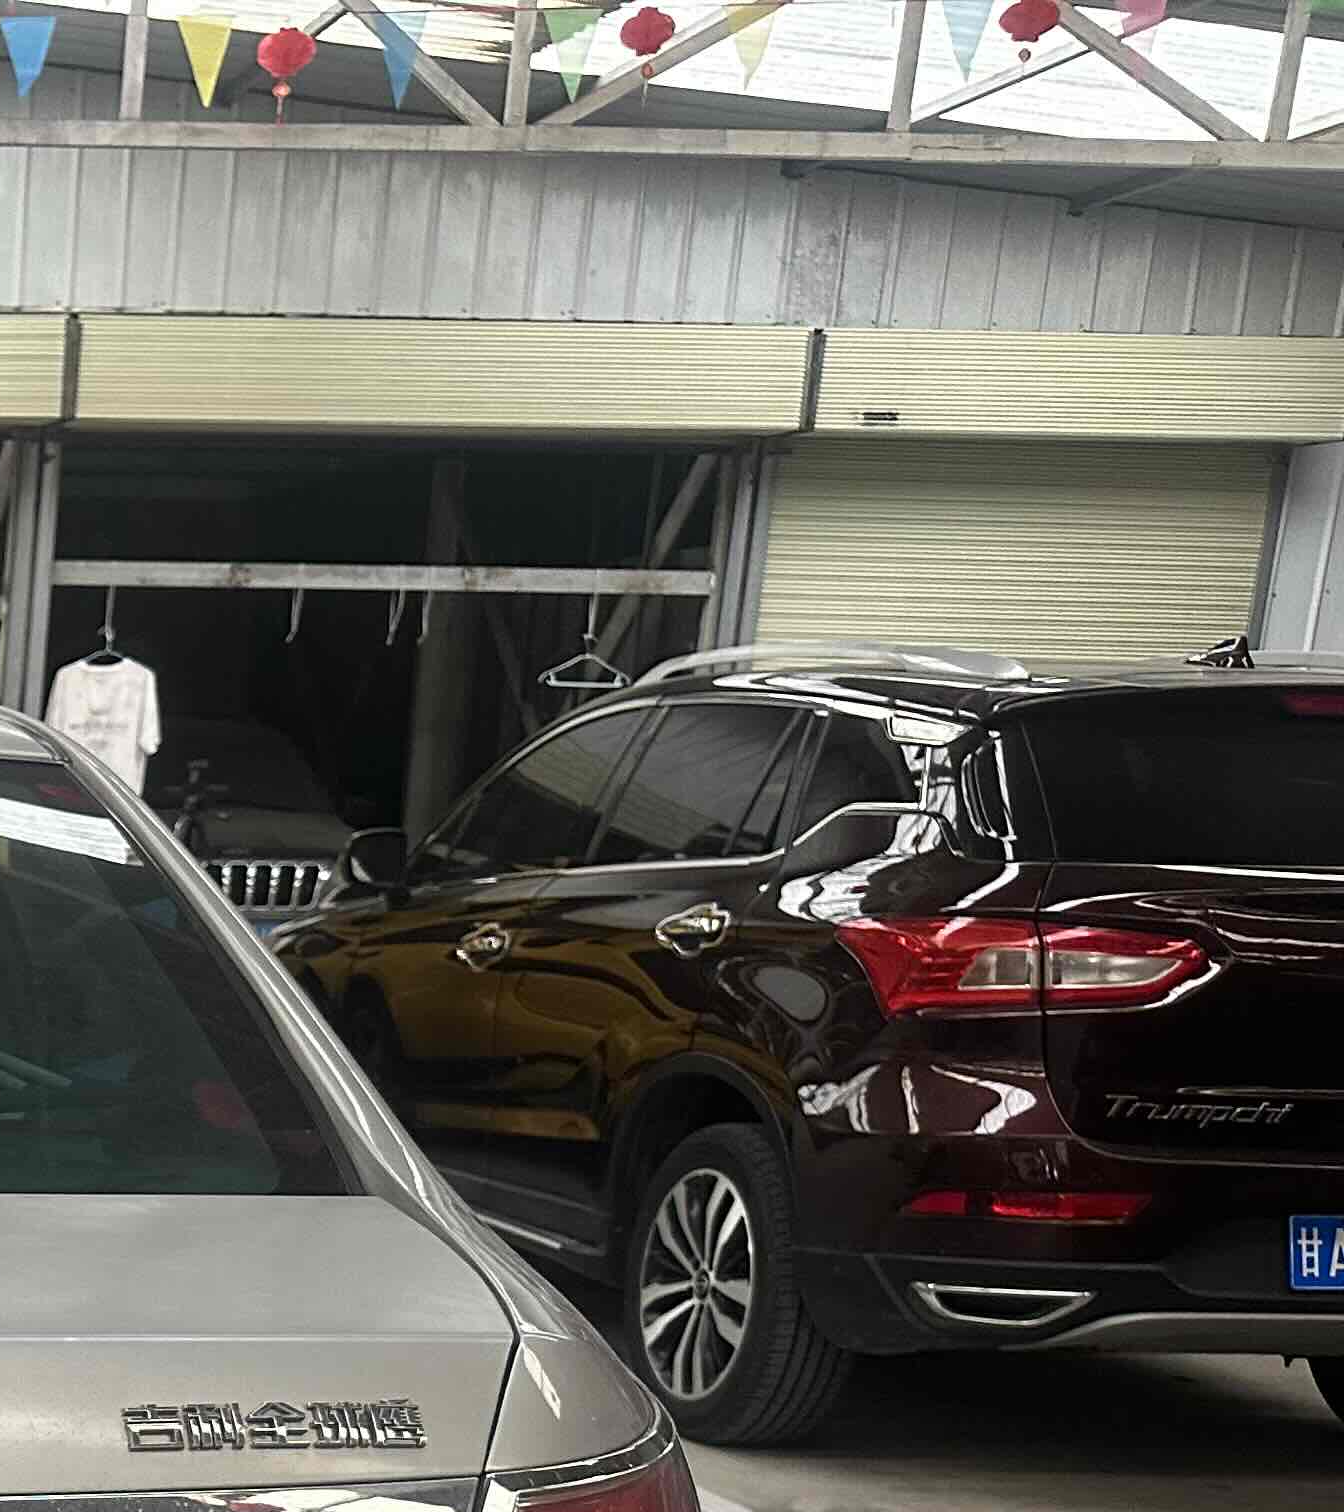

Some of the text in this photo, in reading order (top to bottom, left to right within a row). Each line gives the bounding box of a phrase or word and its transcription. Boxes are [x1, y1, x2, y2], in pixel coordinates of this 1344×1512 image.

[1105, 1094, 1295, 1128] Trumpchi
[121, 1399, 428, 1452] 吉利全球鹰
